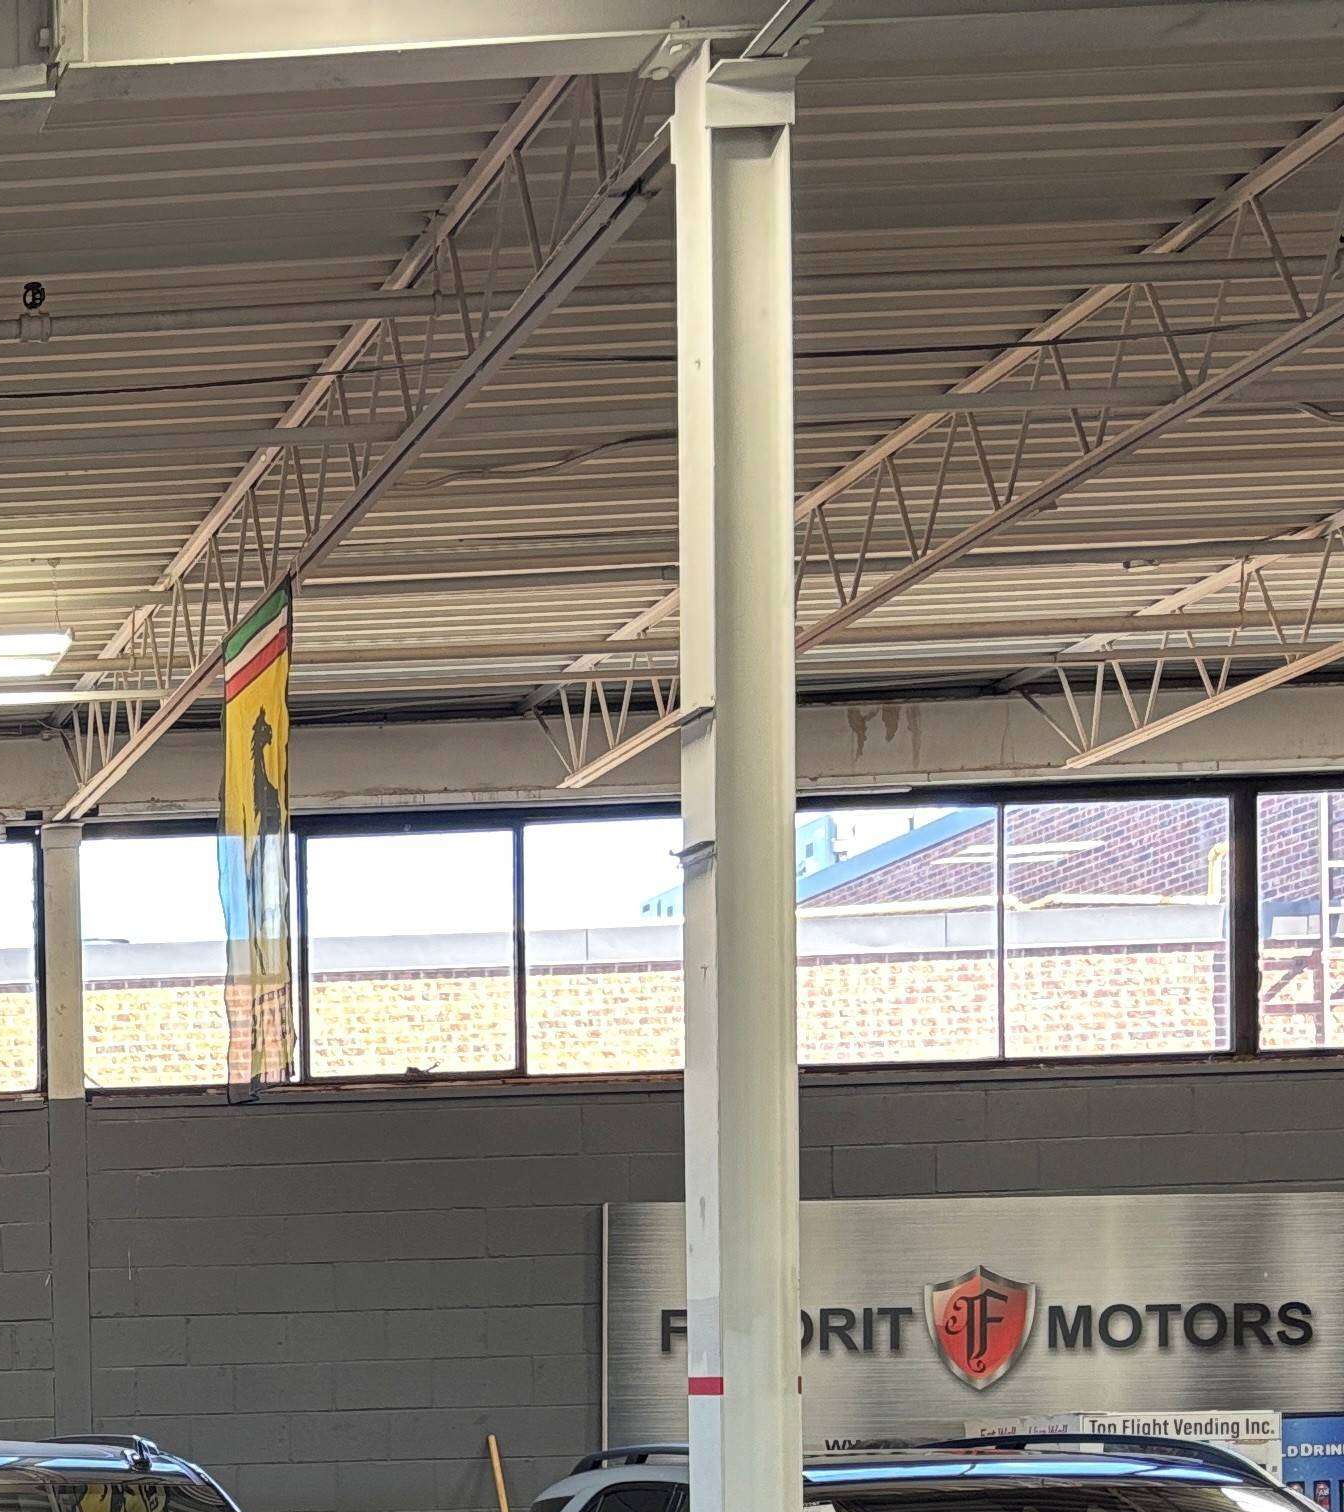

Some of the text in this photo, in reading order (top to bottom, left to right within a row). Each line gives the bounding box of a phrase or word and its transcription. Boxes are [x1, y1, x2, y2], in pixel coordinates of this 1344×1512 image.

[661, 1307, 914, 1354] FRIT
[1048, 1301, 1314, 1351] MOTORS
[1122, 1419, 1169, 1435] Flight
[1173, 1418, 1240, 1438] Vending
[1245, 1418, 1275, 1435] Inc.
